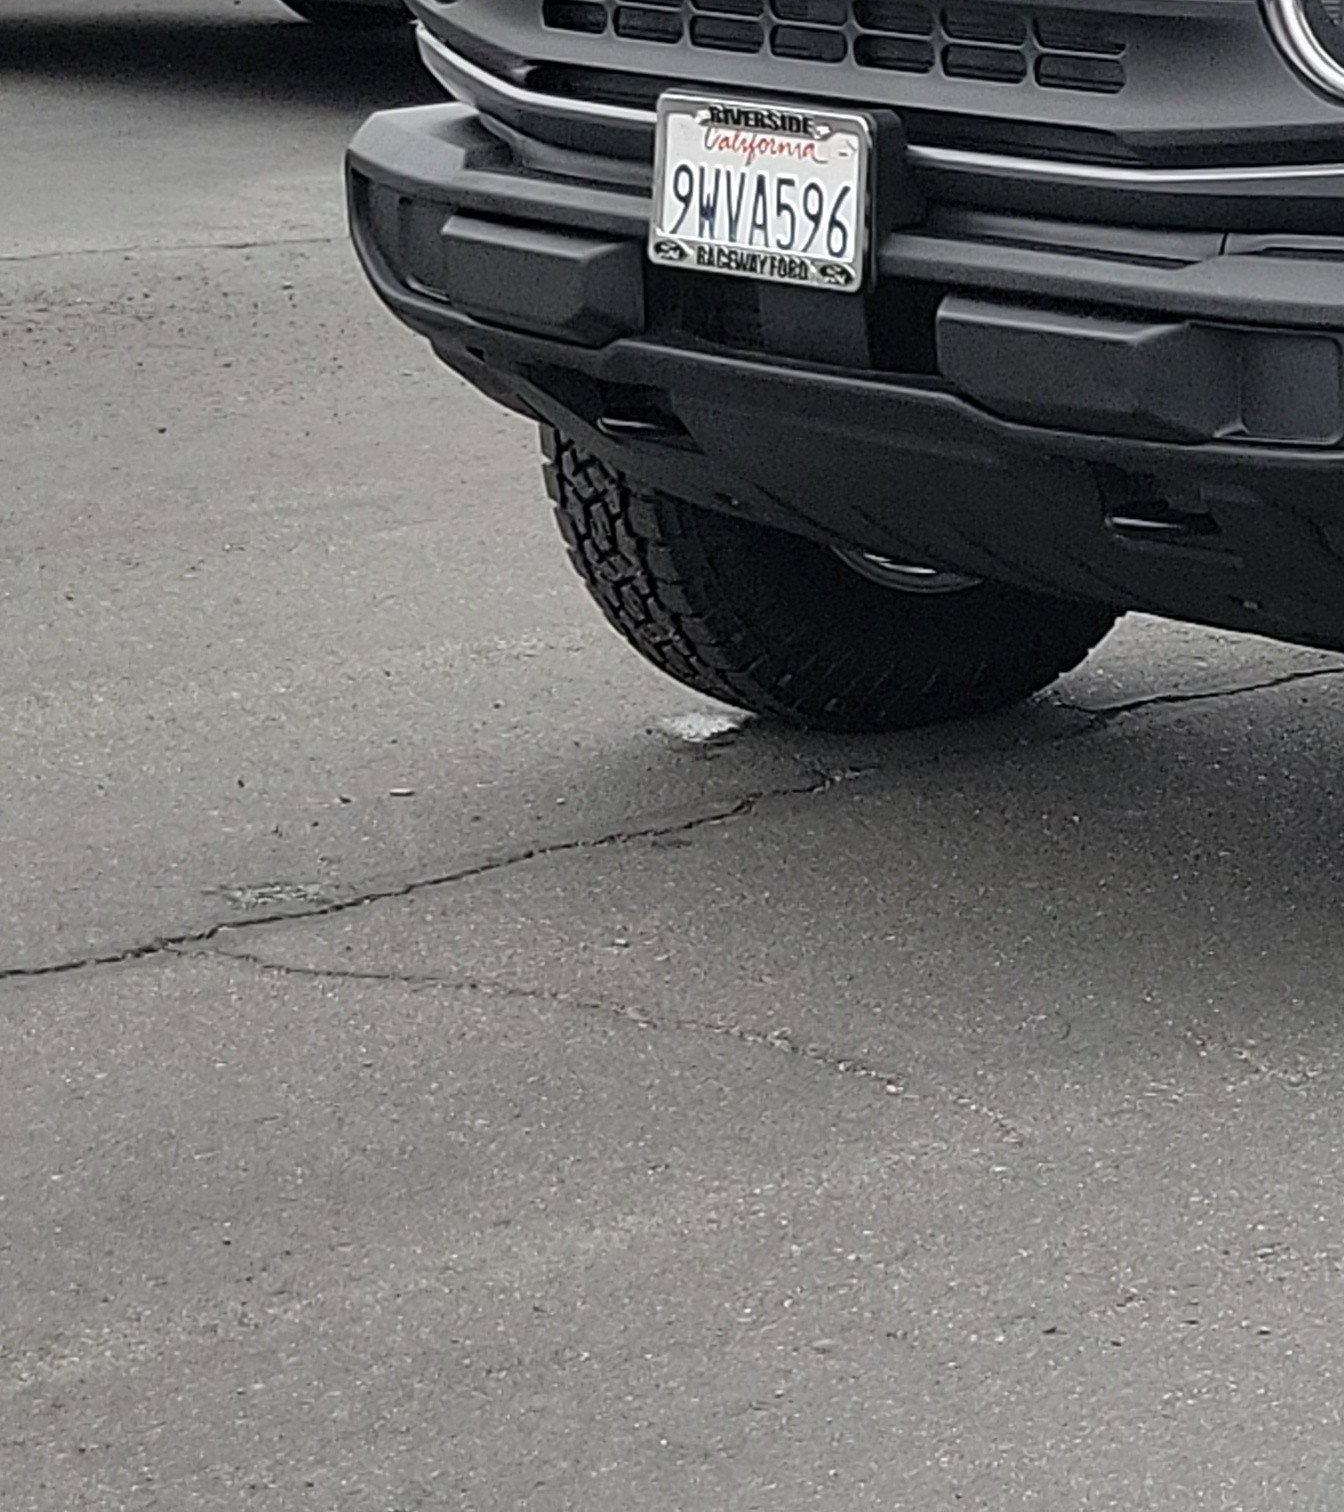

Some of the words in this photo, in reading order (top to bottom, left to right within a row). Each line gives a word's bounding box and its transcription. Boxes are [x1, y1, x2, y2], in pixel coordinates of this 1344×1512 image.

[708, 105, 815, 135] RIVERSIDE
[704, 127, 829, 167] California
[672, 163, 852, 259] 9WVA596
[696, 245, 769, 277] RACEWAY
[770, 255, 809, 281] FORD
